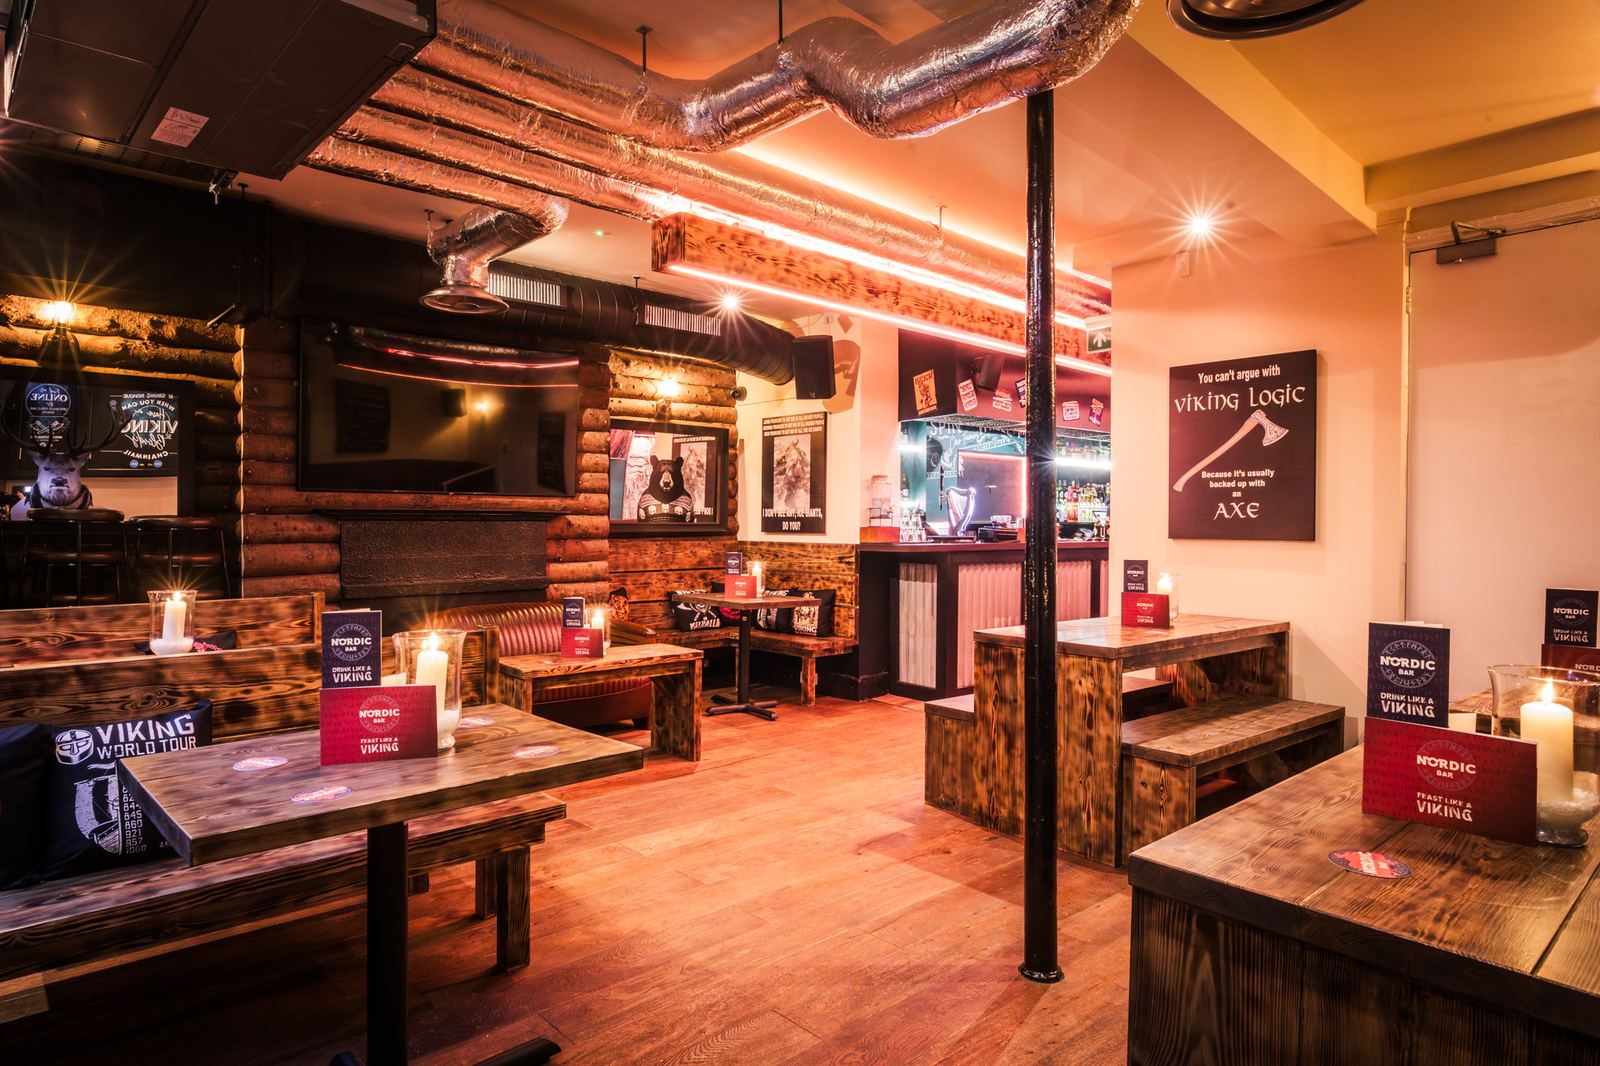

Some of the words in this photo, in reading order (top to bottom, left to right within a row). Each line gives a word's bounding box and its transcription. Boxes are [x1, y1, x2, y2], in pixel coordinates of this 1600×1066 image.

[1198, 372, 1213, 384] You
[1215, 369, 1235, 382] can't
[1237, 368, 1260, 382] argue
[1262, 364, 1281, 377] with
[1174, 391, 1239, 413] VIKING
[1249, 383, 1306, 408] LOGIC
[1201, 471, 1232, 479] Because
[1234, 469, 1246, 478] it's
[1247, 468, 1275, 478] usually
[1209, 480, 1236, 488] backed
[1237, 481, 1247, 489] up
[1248, 479, 1266, 487] with
[1213, 502, 1260, 521] AXE
[331, 637, 372, 647] NORDIC
[1554, 634, 1588, 643] VIKING
[1380, 655, 1436, 671] NORDIC
[332, 671, 373, 683] VIKING
[1398, 668, 1415, 677] BAR
[1380, 692, 1406, 702] DRINK
[1407, 695, 1427, 704] LIKE
[1428, 697, 1434, 705] A
[359, 708, 400, 718] NORDIC
[1381, 700, 1436, 718] VIKING
[95, 714, 195, 745] VIKING
[97, 741, 156, 760] WORLD
[159, 736, 197, 753] TOUR
[360, 742, 399, 755] VIKING
[1416, 754, 1476, 775] NORDIC
[1436, 769, 1454, 779] BAR
[1416, 791, 1444, 803] FEAST
[1445, 797, 1464, 807] LIKE
[1466, 801, 1472, 809] A
[124, 810, 143, 820] 845
[1417, 799, 1473, 822] VIKING
[124, 820, 143, 829] 860
[125, 829, 142, 838] 921
